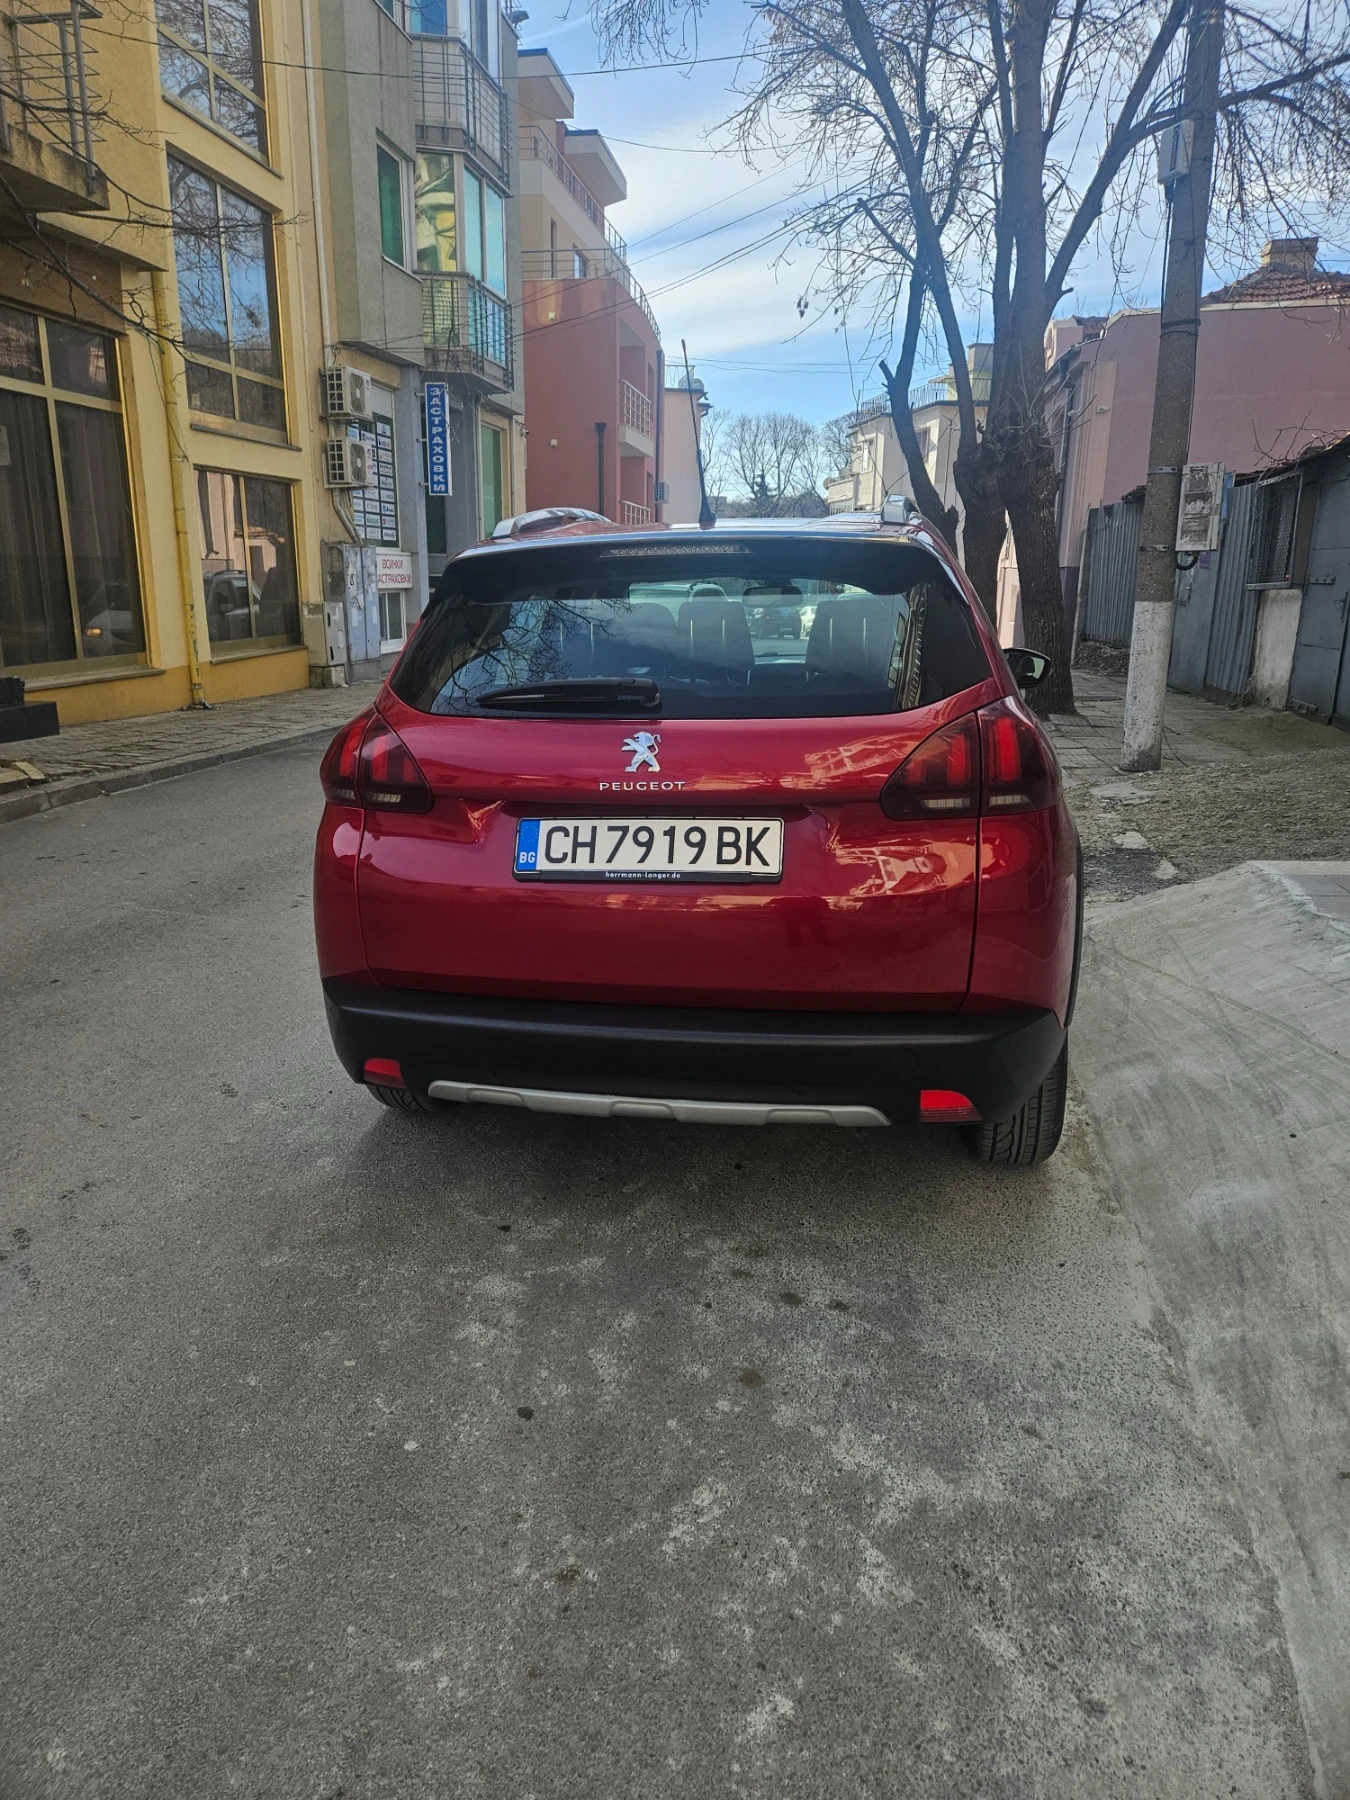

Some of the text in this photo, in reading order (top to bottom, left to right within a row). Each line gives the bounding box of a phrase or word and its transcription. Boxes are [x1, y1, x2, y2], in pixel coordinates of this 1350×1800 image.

[430, 387, 446, 492] ЗАСТРАХОВКИ
[382, 558, 403, 569] ВСИЧКИ
[377, 573, 411, 583] АСТРАХОВКИ
[599, 781, 686, 791] PEUGEOT
[519, 851, 536, 863] BG
[605, 871, 681, 879] herrmann-langer.de
